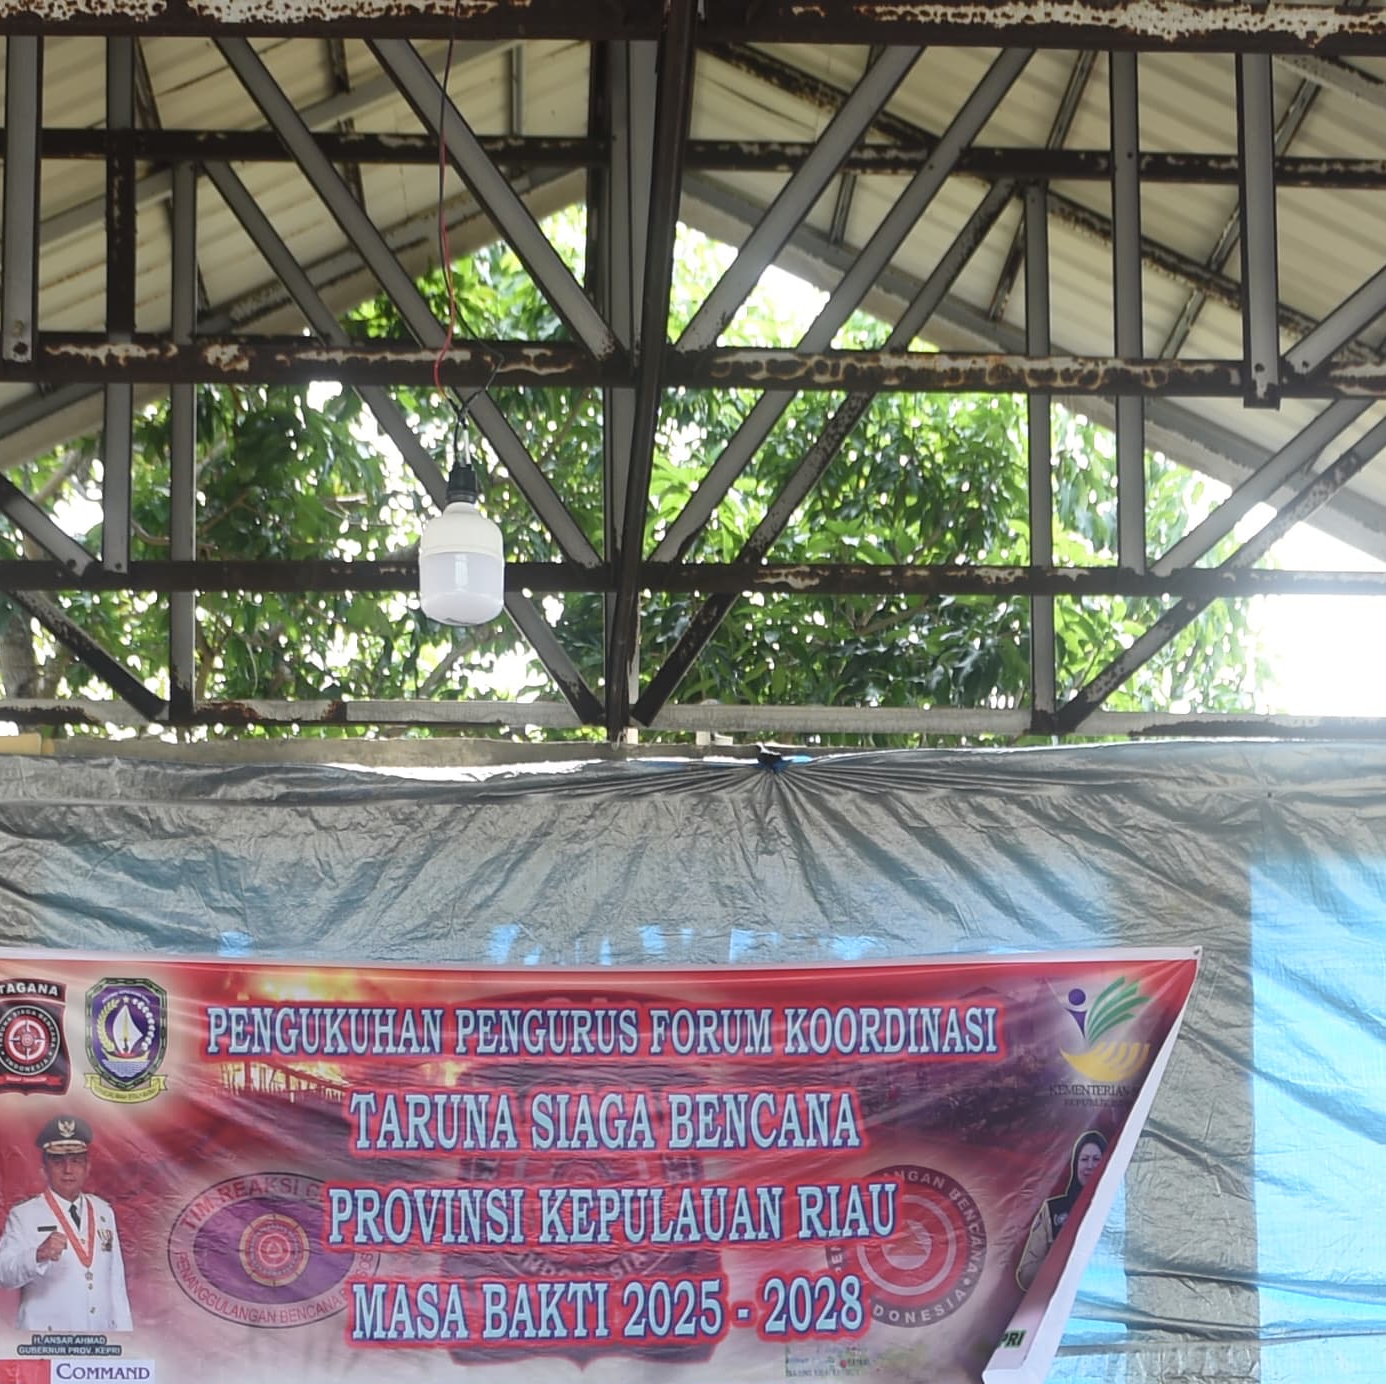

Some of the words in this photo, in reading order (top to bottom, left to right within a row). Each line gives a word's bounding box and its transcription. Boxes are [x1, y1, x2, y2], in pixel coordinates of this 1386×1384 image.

[206, 1005, 443, 1056] PENGUKUHAN
[455, 1006, 639, 1055] PENGURUS
[649, 1006, 773, 1055] FORUM
[783, 1006, 999, 1055] KOORDINASI
[349, 1091, 518, 1151] TARUNA
[531, 1091, 656, 1151] SIAGA
[668, 1090, 862, 1149] BENCANA
[180, 1199, 218, 1231] TIM
[217, 1177, 298, 1203] REAKSI
[327, 1187, 525, 1246] PROVINSI
[538, 1185, 784, 1245] KEPULAUAN
[796, 1182, 898, 1240] RIAU
[948, 1187, 983, 1275] BENCANA
[279, 1299, 342, 1325] BENCANA
[351, 1281, 470, 1344] MASA
[481, 1281, 610, 1340] BAKTI
[621, 1278, 725, 1338] 2025
[763, 1274, 864, 1334] 2028
[871, 1287, 967, 1324] DONESIA
[18, 1345, 67, 1355] GUBERNUR
[96, 1345, 121, 1355] KEPRI
[44, 1336, 73, 1345] ANSAR
[75, 1336, 106, 1345] AHMAD
